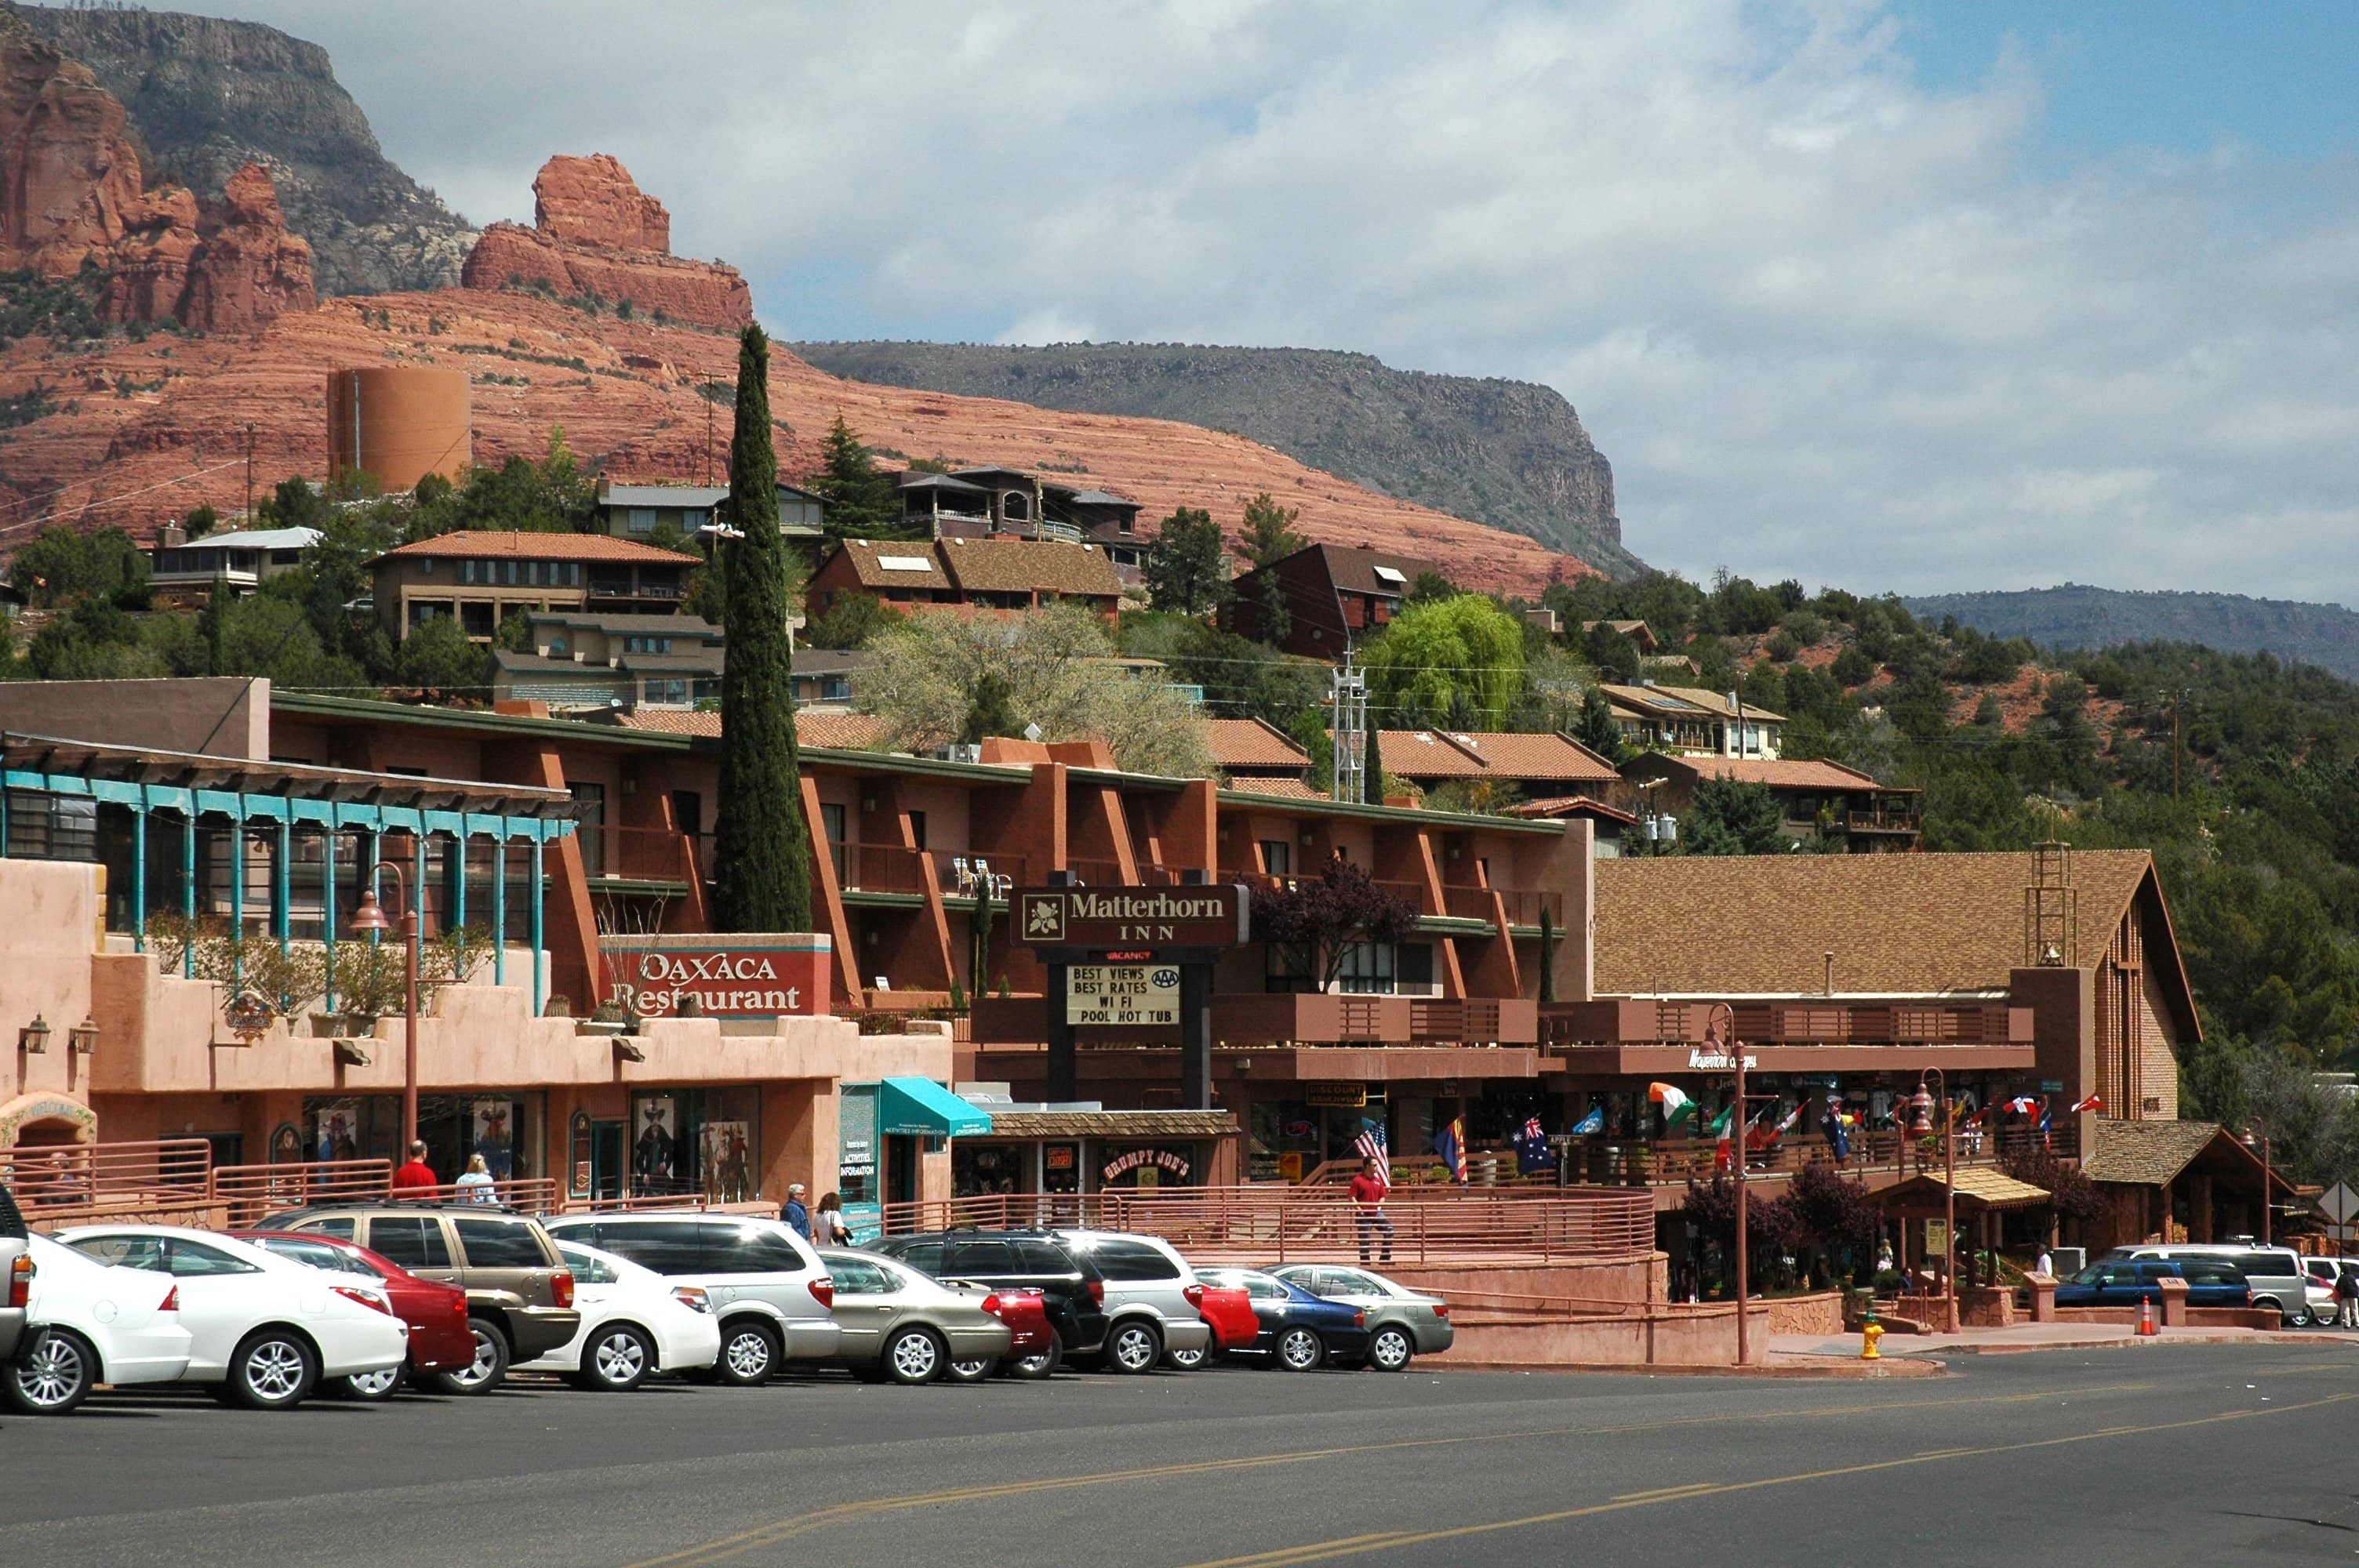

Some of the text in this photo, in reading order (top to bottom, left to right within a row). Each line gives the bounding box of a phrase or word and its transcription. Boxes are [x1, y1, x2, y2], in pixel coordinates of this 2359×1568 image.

[1070, 893, 1224, 918] Matterhorn
[1120, 926, 1173, 940] INN
[1107, 951, 1151, 960] VACANCY
[1074, 968, 1144, 979] BEST VIEWS
[1153, 971, 1177, 985] AAA
[1074, 982, 1147, 993] BEST RATES
[1100, 996, 1132, 1007] WI FI
[1081, 1011, 1172, 1022] POOL HOT TUB
[1103, 1149, 1190, 1181] GRUMPY JOE'S
[841, 1165, 874, 1177] INFORMATION
